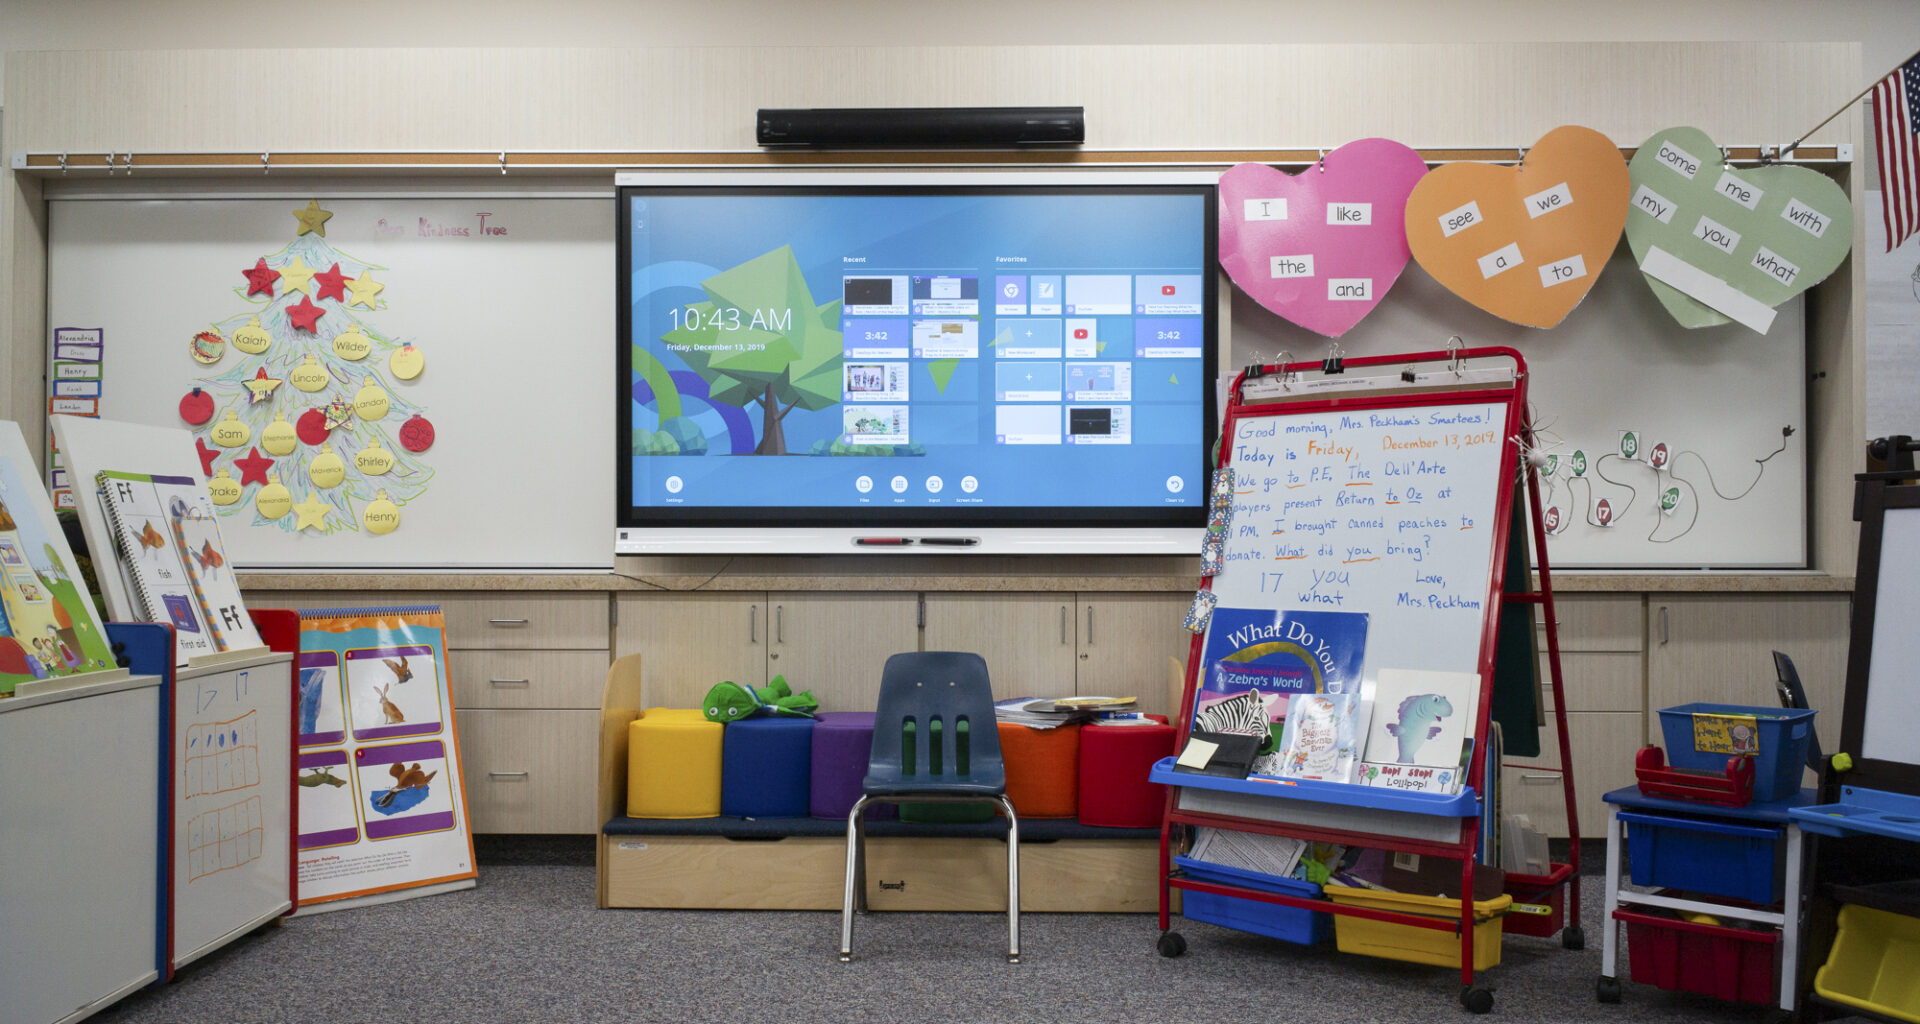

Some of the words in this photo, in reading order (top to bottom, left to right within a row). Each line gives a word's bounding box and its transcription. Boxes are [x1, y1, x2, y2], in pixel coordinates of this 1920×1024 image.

[1659, 146, 1698, 175] come
[1725, 181, 1751, 202] me
[1261, 201, 1271, 217] I
[1536, 194, 1561, 211] we
[1640, 195, 1668, 218] my
[1336, 206, 1362, 221] like
[1448, 211, 1474, 230] see
[1789, 206, 1822, 233] with
[418, 217, 470, 237] Kindness
[1701, 225, 1731, 249] you
[1278, 259, 1306, 274] the
[1496, 256, 1507, 268] a
[1756, 253, 1796, 282] what
[1552, 265, 1573, 280] to
[1336, 282, 1365, 297] and
[669, 308, 741, 331] 10:43
[749, 308, 792, 331] AM
[235, 334, 267, 347] Kaiah
[865, 331, 888, 341] 3:42
[1157, 331, 1181, 340] 3:42
[336, 341, 368, 352] Wilder
[666, 344, 692, 352] Friday,
[694, 343, 732, 351] December
[735, 344, 745, 352] 13,
[64, 368, 88, 377] Henry
[293, 374, 326, 383] Lincoln
[355, 398, 387, 409] Landon
[1239, 421, 1276, 439] Good
[1286, 421, 1333, 438] morning,
[1340, 416, 1363, 430] Mrs.
[1370, 414, 1420, 427] Peckham's
[218, 429, 243, 440] Sam
[263, 433, 295, 442] Stephanie
[1237, 445, 1275, 467] Today
[1286, 448, 1297, 460] is
[1307, 440, 1359, 462] Friday,
[1382, 435, 1438, 450] December
[1444, 434, 1461, 450] 13,
[1623, 439, 1636, 451] 18
[357, 456, 391, 469] Shirley
[1651, 448, 1666, 463] 19
[311, 466, 343, 475] Maverick
[1238, 473, 1256, 488] We
[1264, 478, 1278, 493] go
[1288, 470, 1299, 483] to
[1310, 466, 1333, 482] P.E.
[1348, 463, 1371, 479] The
[116, 482, 134, 503] Ff
[208, 486, 238, 496] Drake
[258, 497, 290, 505] Alexandria
[1231, 503, 1271, 520] players
[1284, 496, 1322, 515] present
[1336, 490, 1375, 507] Return
[1386, 488, 1398, 501] to
[1406, 487, 1423, 500] Oz
[1438, 487, 1452, 499] at
[1662, 493, 1678, 505] 20
[365, 511, 397, 524] Henry
[1545, 513, 1557, 527] 15
[1598, 507, 1611, 519] 17
[1240, 525, 1259, 538] PM.
[1272, 519, 1285, 533] I
[1295, 519, 1337, 536] brought
[1398, 517, 1447, 533] peaches
[1461, 514, 1474, 527] to
[1225, 547, 1265, 561] donate.
[1275, 544, 1305, 557] What
[1318, 544, 1334, 557] did
[1347, 547, 1372, 561] you
[1386, 534, 1431, 562] bring?
[158, 569, 172, 579] fish
[1415, 569, 1447, 588] Love,
[1260, 572, 1284, 593] 17
[1298, 590, 1344, 605] what
[1397, 592, 1426, 608] Mrs.
[1427, 594, 1480, 610] Peckham
[219, 605, 243, 631] Ff
[181, 639, 195, 649] first
[196, 640, 207, 648] aid
[1226, 623, 1283, 649] What
[1286, 620, 1314, 646] Do
[1314, 638, 1336, 675] You
[235, 671, 249, 702] 17
[1216, 672, 1223, 682] A
[1228, 673, 1268, 687] Zebra's
[1272, 677, 1303, 689] World
[1381, 766, 1401, 777] Hop!
[1407, 768, 1434, 779] Stop!
